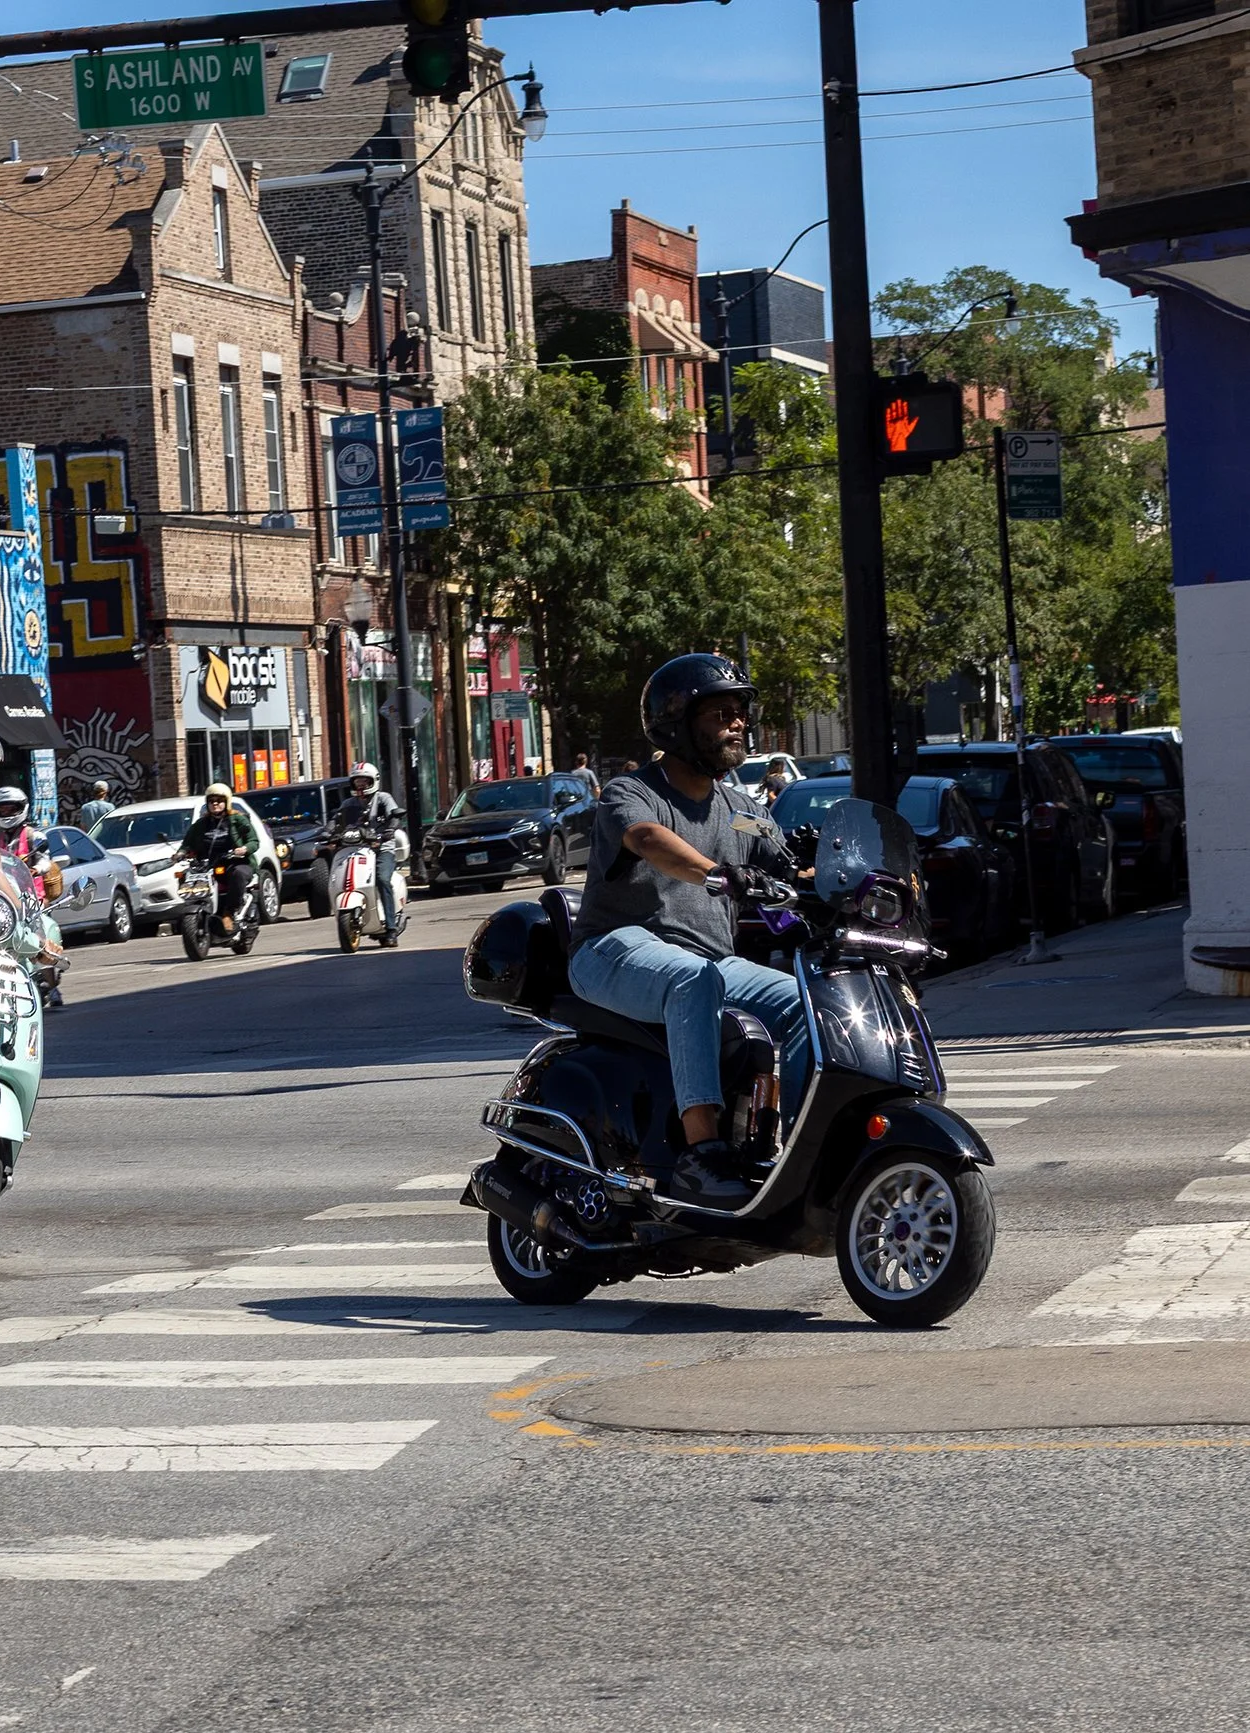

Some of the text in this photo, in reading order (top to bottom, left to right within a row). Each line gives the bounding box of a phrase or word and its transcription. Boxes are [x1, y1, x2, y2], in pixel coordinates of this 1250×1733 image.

[83, 54, 254, 91] S ASHLAND AV
[130, 91, 210, 117] 1600 W
[228, 648, 277, 687] boost
[230, 686, 257, 705] mobile
